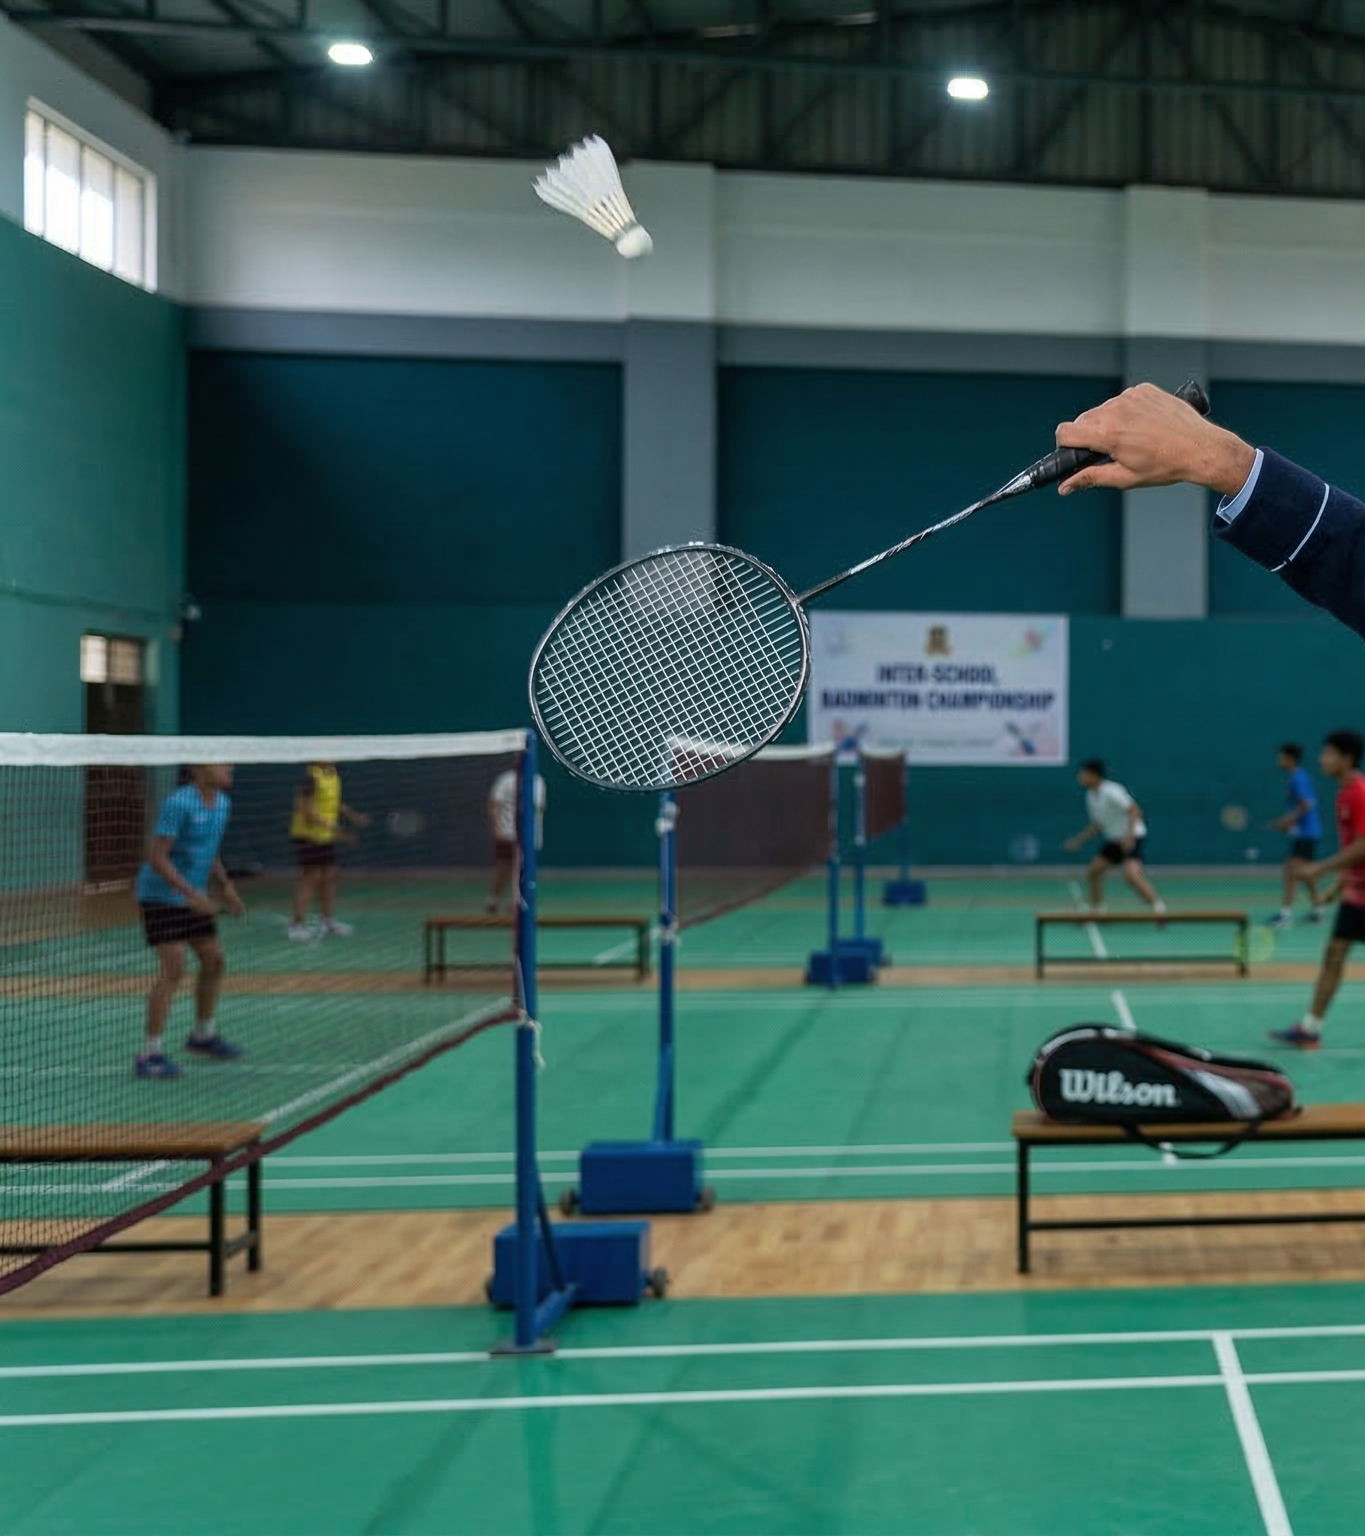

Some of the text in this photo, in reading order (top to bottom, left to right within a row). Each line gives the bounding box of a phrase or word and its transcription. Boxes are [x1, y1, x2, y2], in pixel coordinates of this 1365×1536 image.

[877, 664, 997, 683] INTER-SCHOOL
[822, 688, 1054, 710] BADMINTON CHAMPIONSHIP
[1060, 1068, 1178, 1107] Wilson
